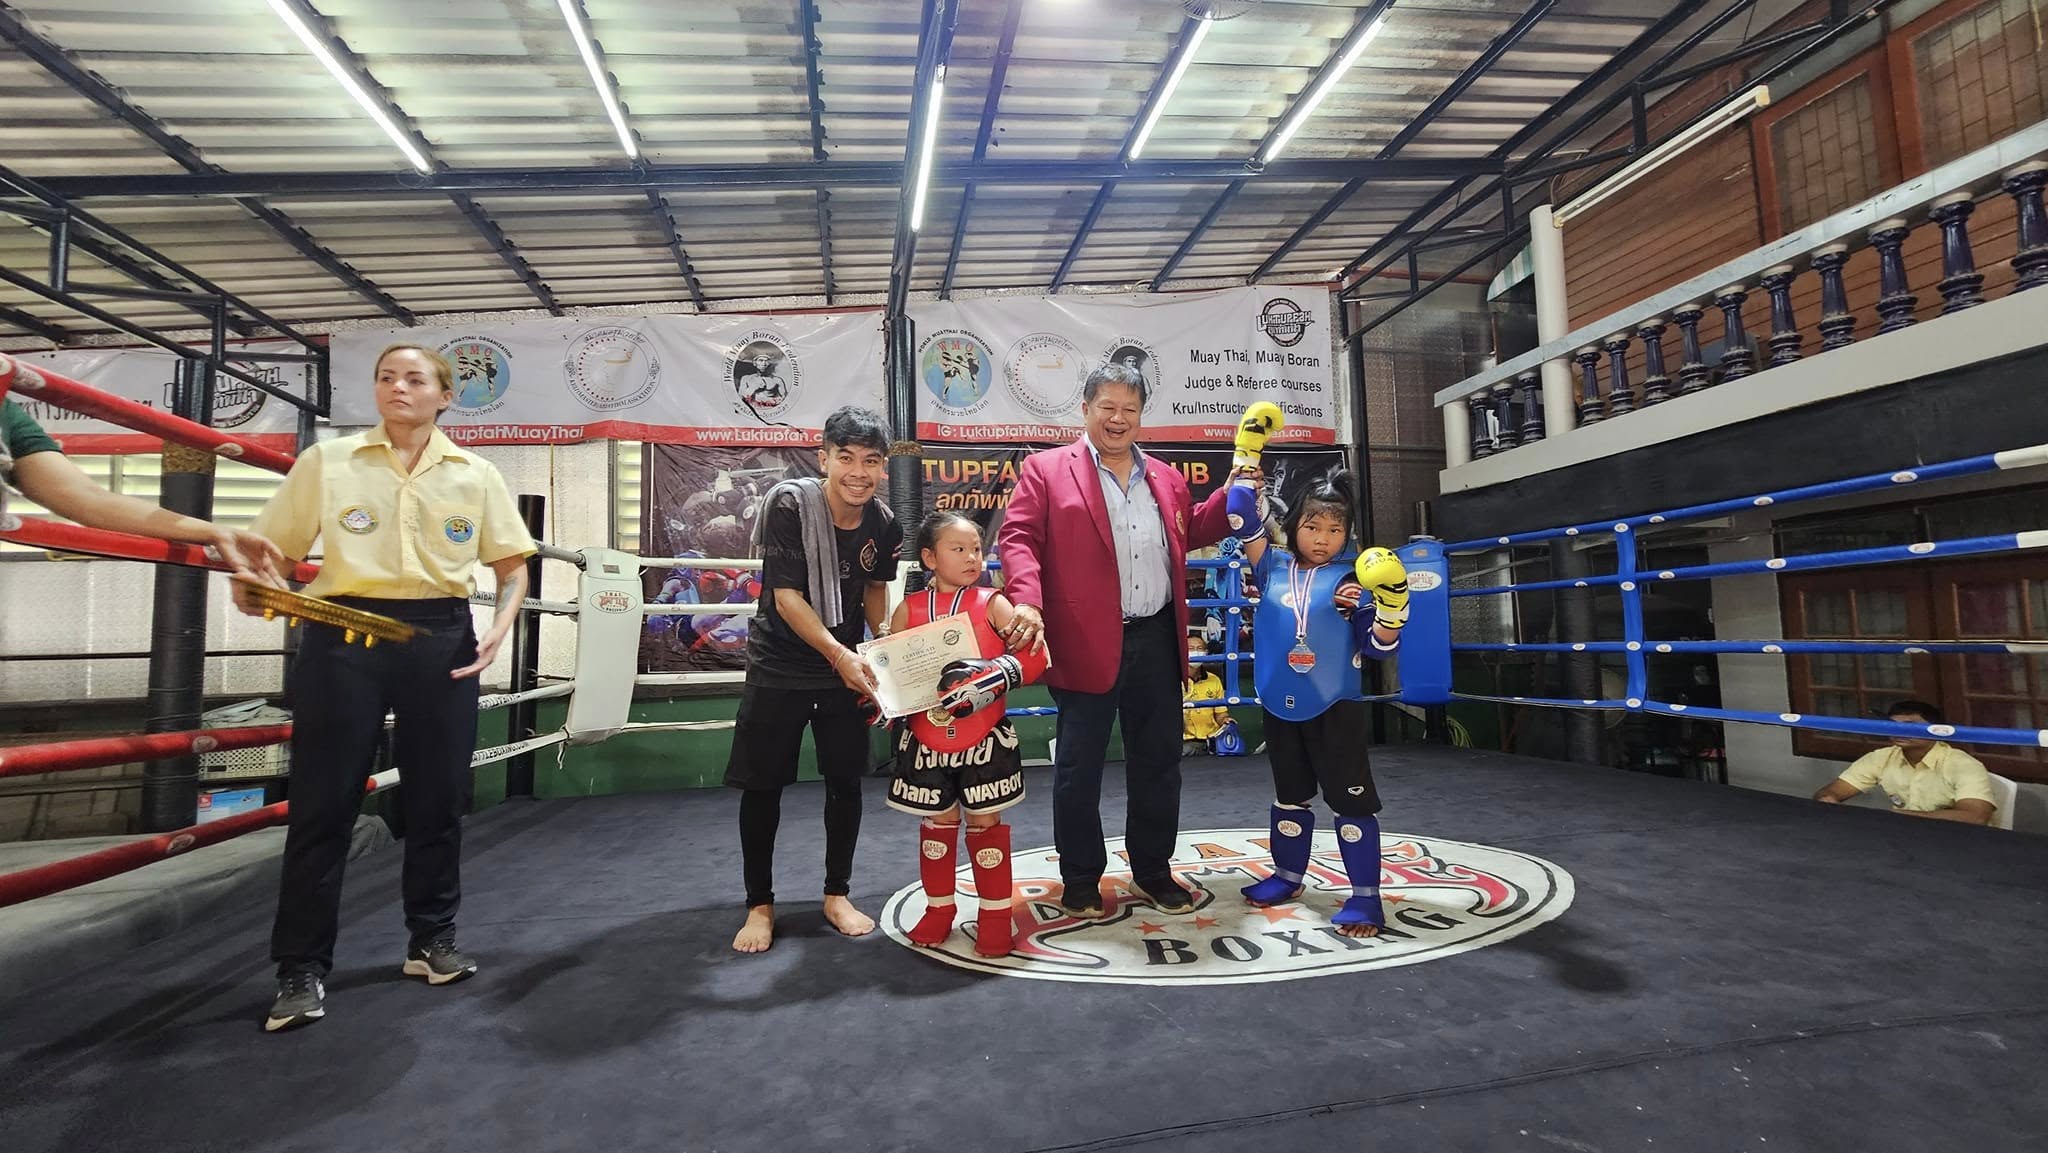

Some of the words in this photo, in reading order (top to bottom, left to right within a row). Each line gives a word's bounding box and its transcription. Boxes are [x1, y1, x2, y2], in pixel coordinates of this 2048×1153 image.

[479, 335, 513, 359] ORGANIZATION
[960, 329, 994, 356] ORGANIZATION
[723, 356, 736, 382] World
[730, 336, 751, 355] Muay
[752, 331, 781, 343] Boran
[781, 342, 802, 387] Federation
[1104, 343, 1119, 359] Muay
[1120, 337, 1144, 348] Boran
[1144, 345, 1163, 386] Federation
[1190, 349, 1220, 365] Muay
[1224, 349, 1250, 365] Thai,
[1256, 351, 1285, 366] Muay
[1288, 353, 1320, 367] Boran
[1184, 376, 1222, 391] Judge
[1225, 375, 1234, 387] &
[1237, 375, 1278, 390] Referee
[1281, 379, 1322, 392] courses
[960, 424, 1087, 440] LuktupfahMuayTha
[964, 771, 1022, 804] WAYBOY
[1141, 906, 1464, 967] BOXING
